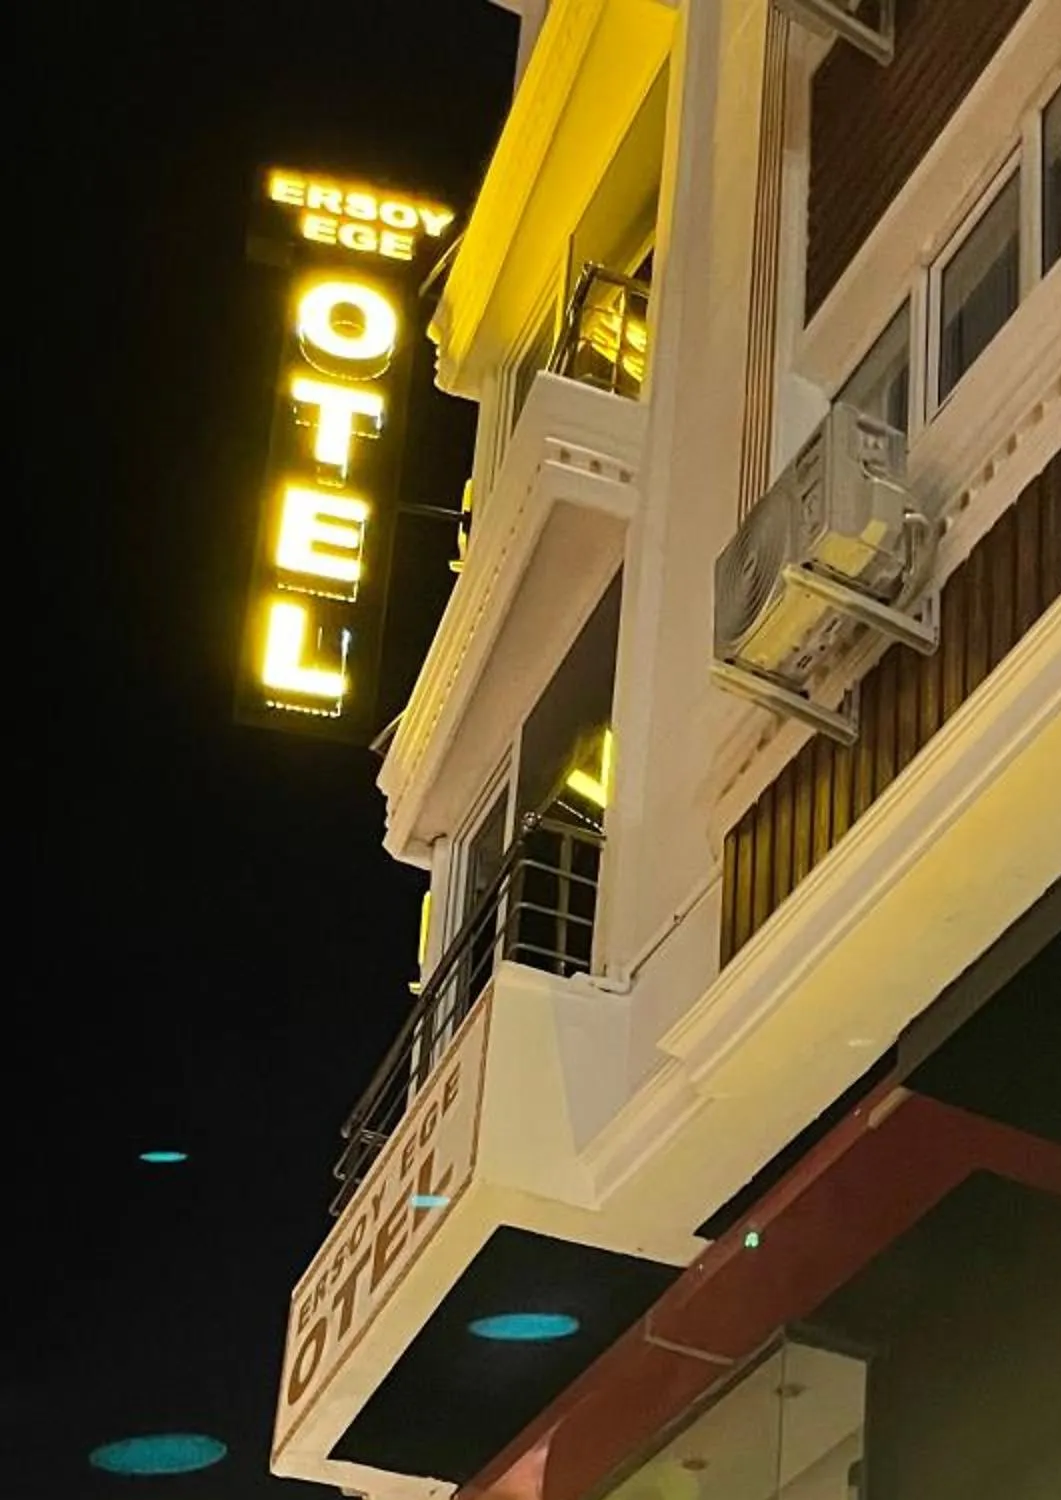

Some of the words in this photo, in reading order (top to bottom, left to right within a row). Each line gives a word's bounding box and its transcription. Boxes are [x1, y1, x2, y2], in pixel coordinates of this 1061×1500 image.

[270, 175, 456, 237] ERSOY
[303, 213, 414, 261] EGE
[262, 280, 399, 699] OTEL
[287, 1147, 454, 1406] OTEL
[298, 1180, 389, 1335] ERSOY
[400, 1062, 461, 1175] EGE
